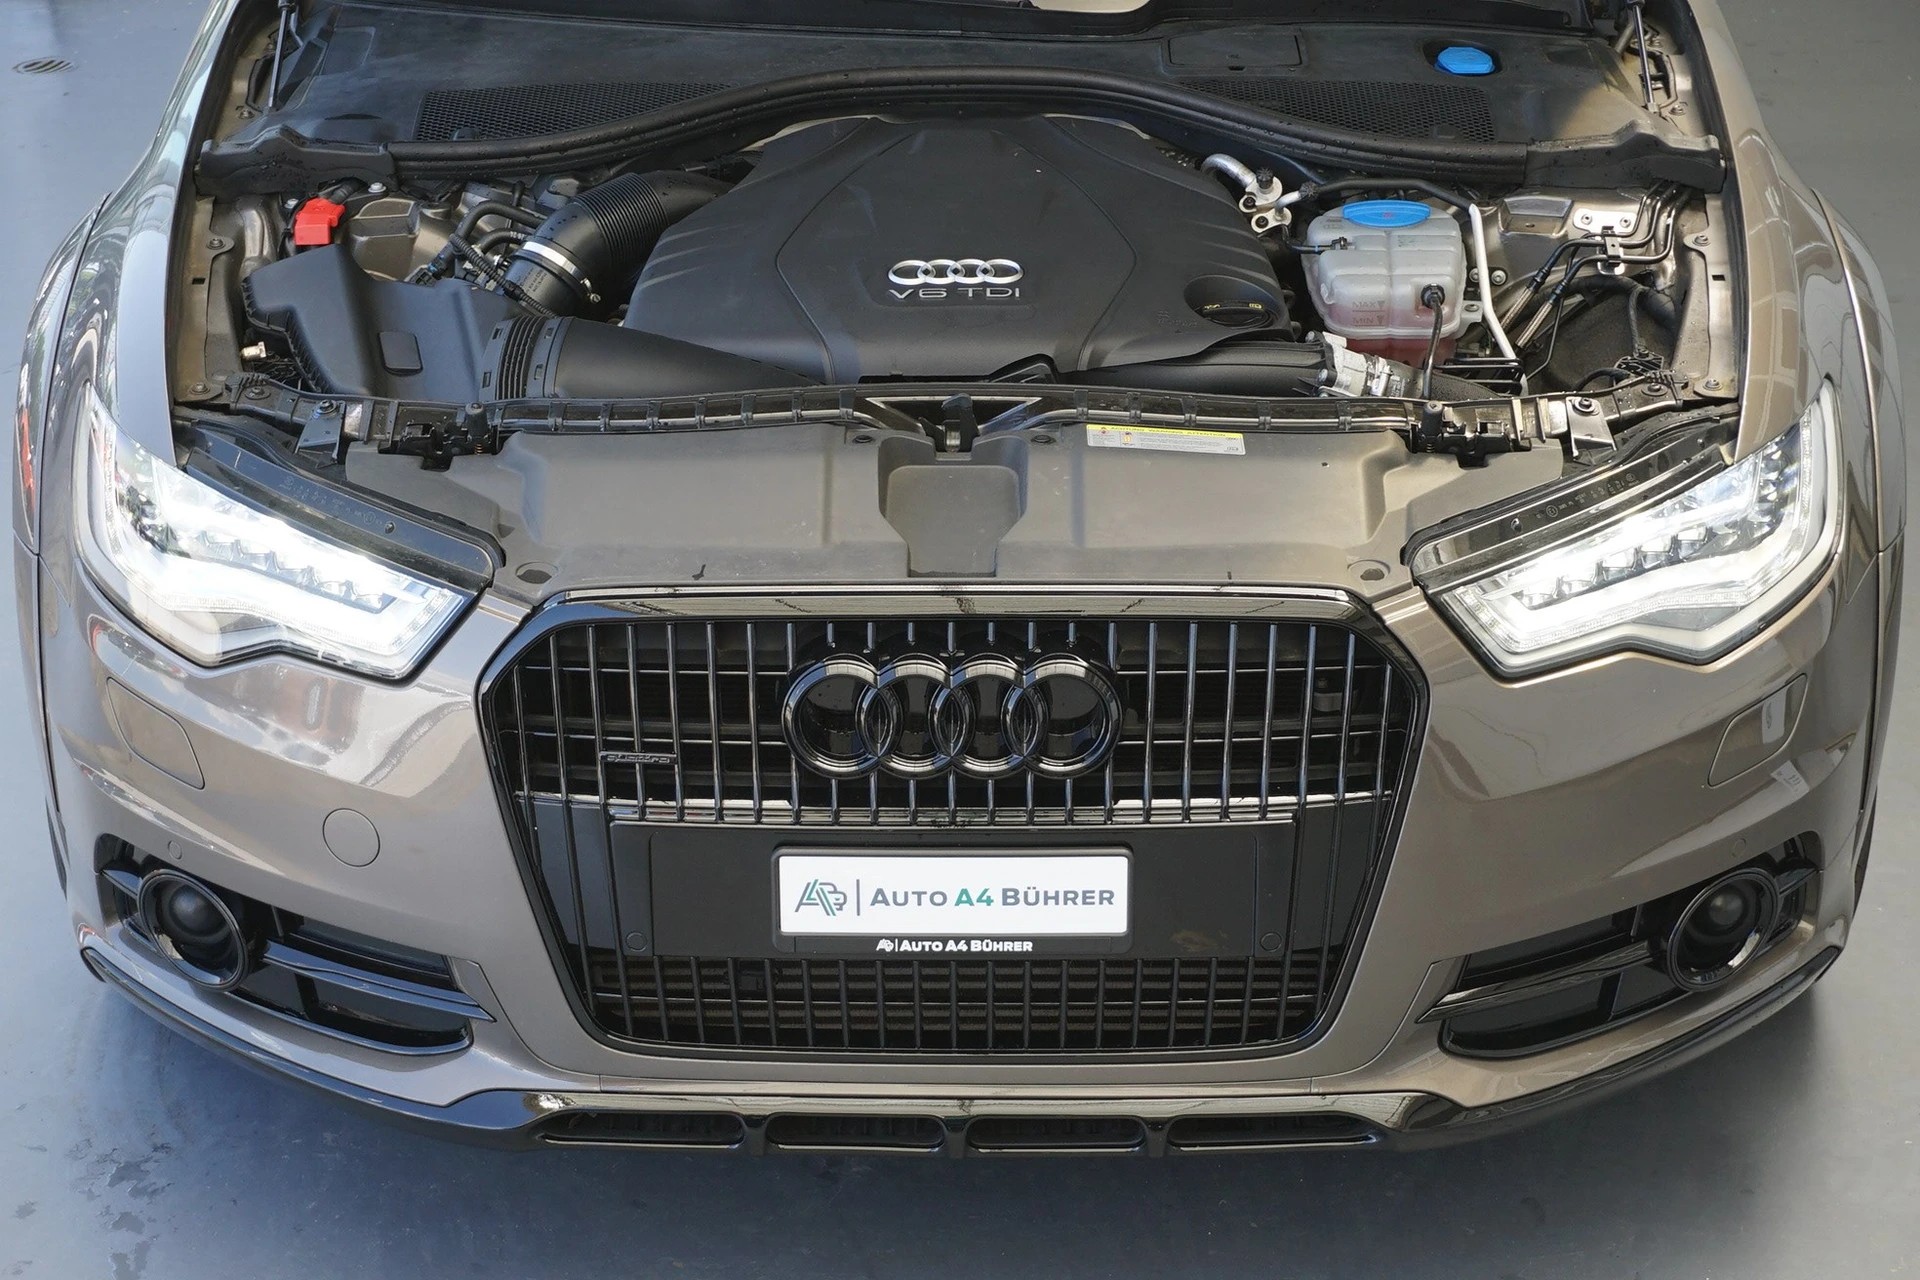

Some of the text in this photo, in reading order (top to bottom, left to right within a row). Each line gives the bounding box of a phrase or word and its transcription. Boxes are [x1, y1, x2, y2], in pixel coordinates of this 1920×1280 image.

[889, 287, 1020, 299] V6 TDI
[1352, 300, 1377, 309] MAX
[1352, 316, 1375, 325] MIN
[870, 886, 1115, 907] AUTO A4 BÜHRER
[900, 939, 944, 952] AUTO
[945, 939, 968, 952] A4
